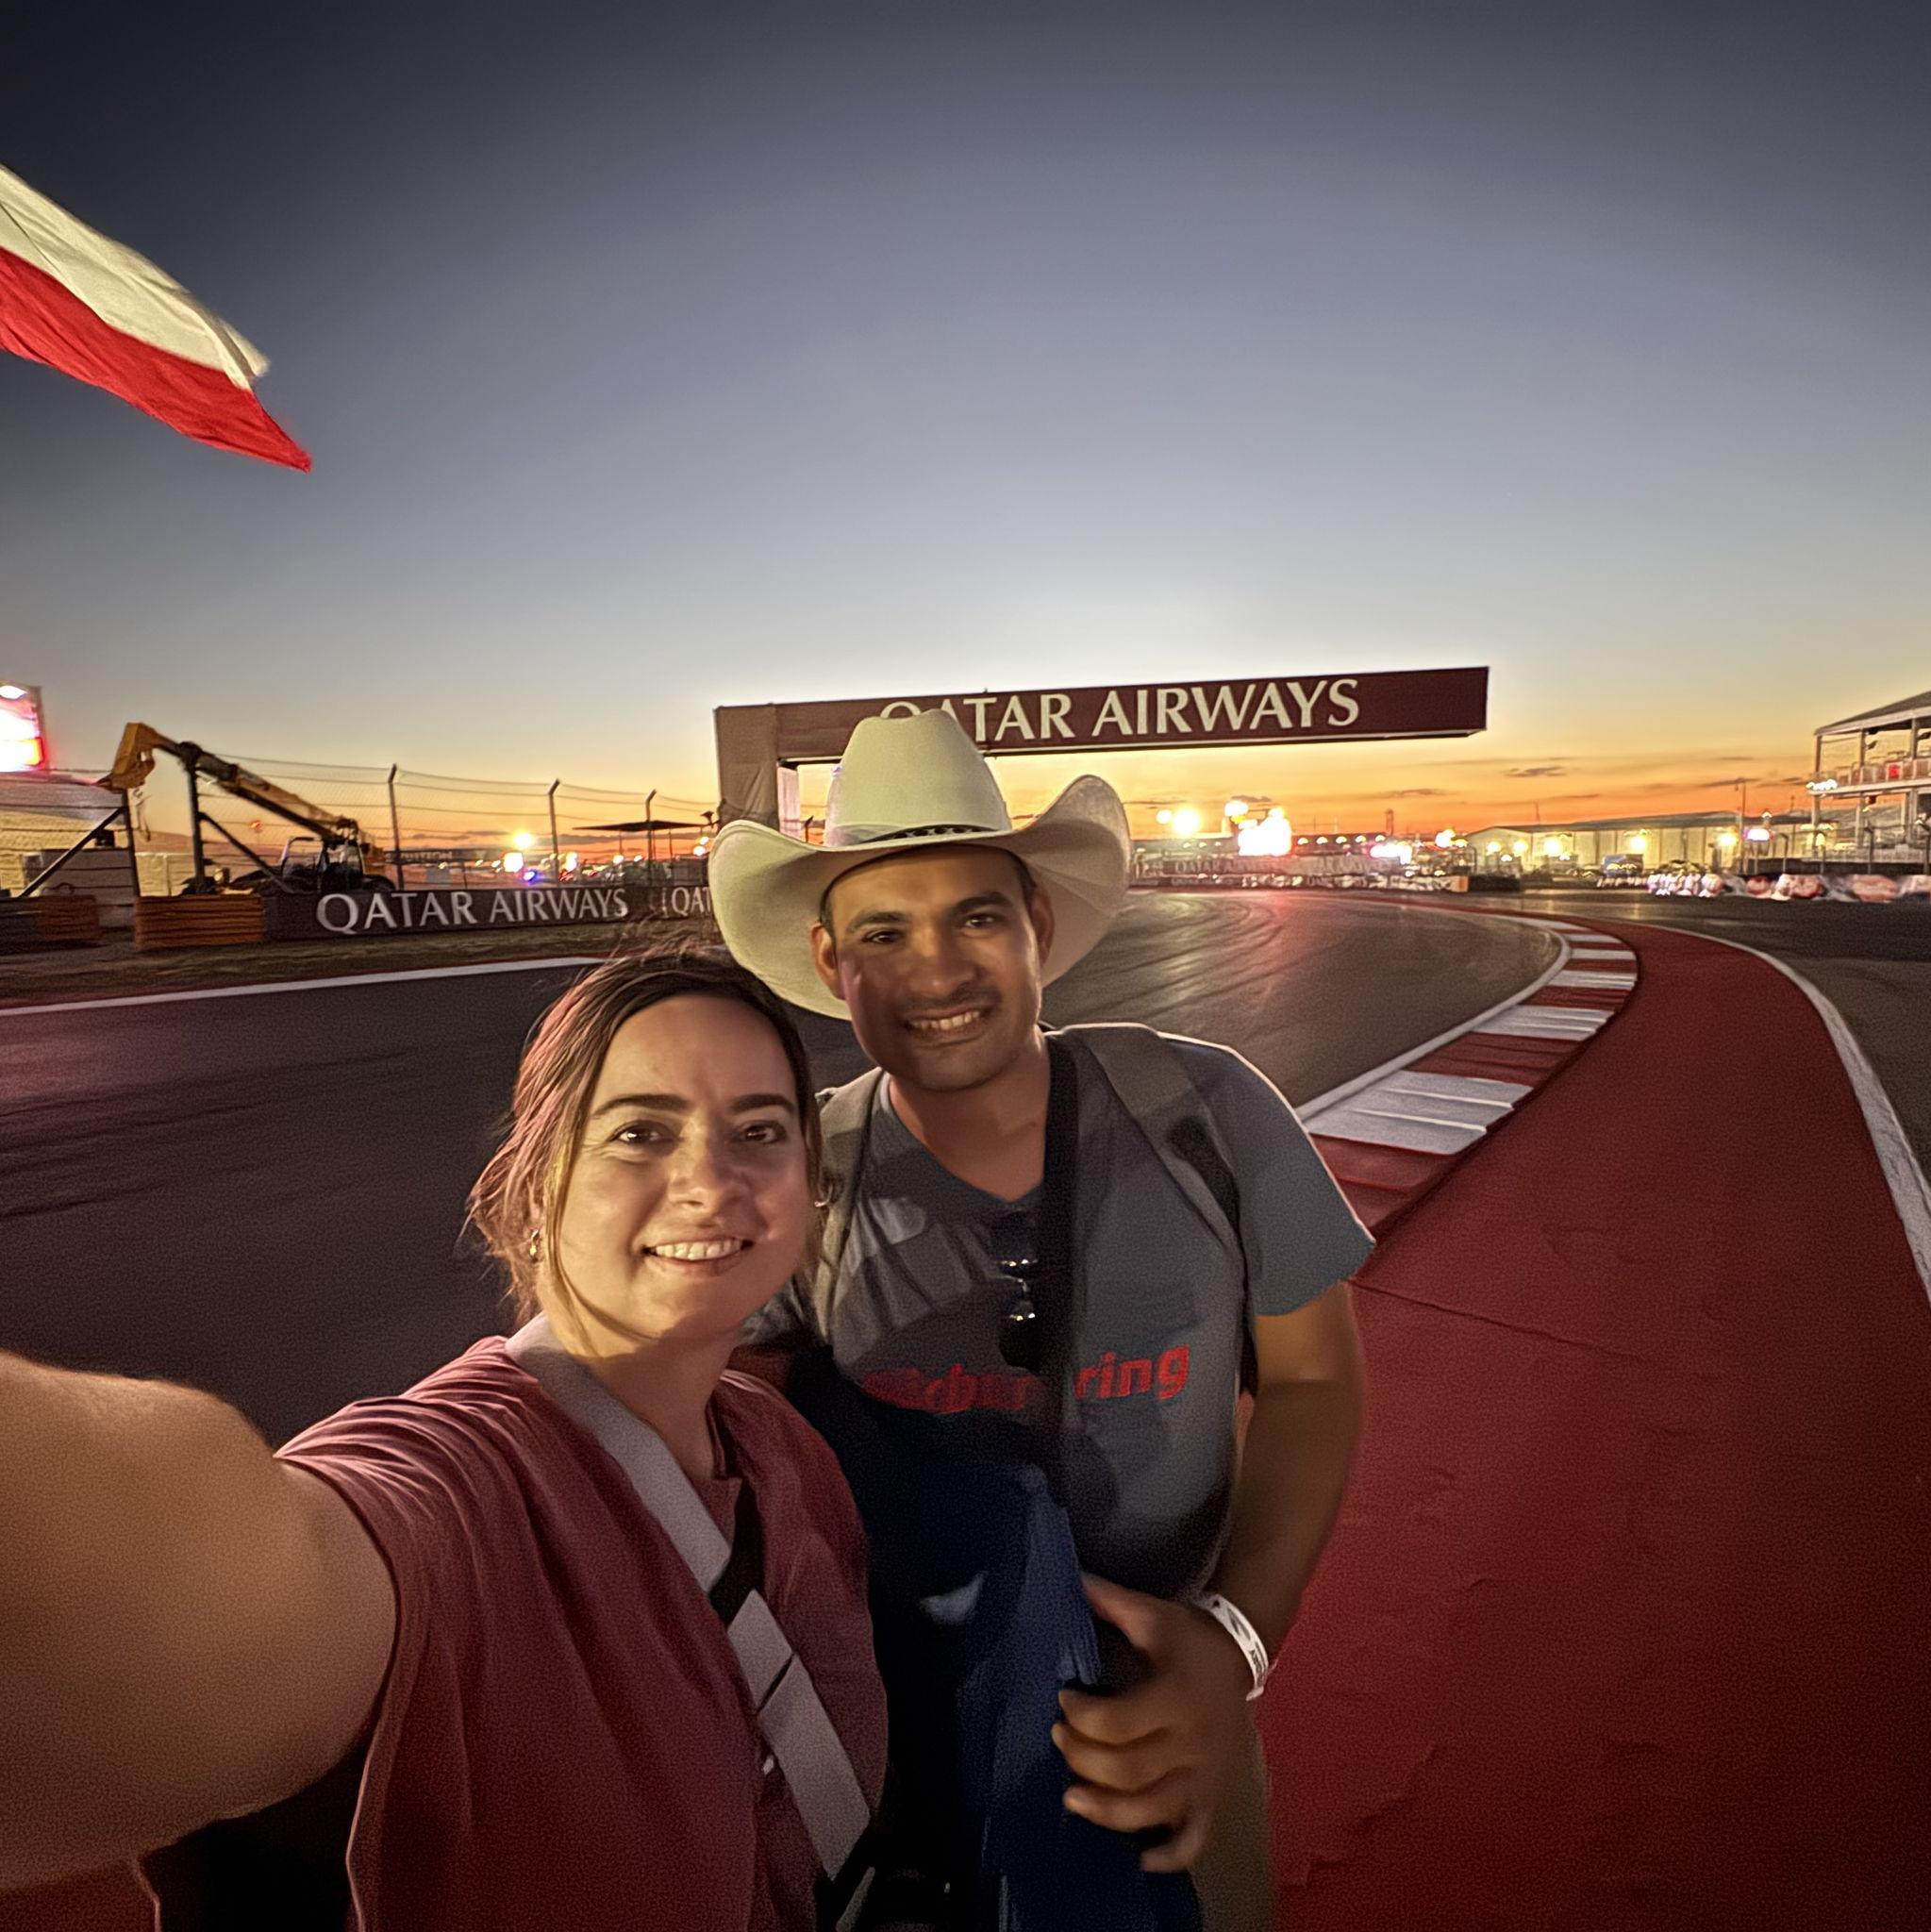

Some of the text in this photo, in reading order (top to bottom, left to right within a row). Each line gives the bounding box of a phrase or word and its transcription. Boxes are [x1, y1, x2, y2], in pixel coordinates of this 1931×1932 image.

[880, 678, 1359, 742] TAR AIRWAYS
[316, 888, 628, 934] QATAR AIRWAYS
